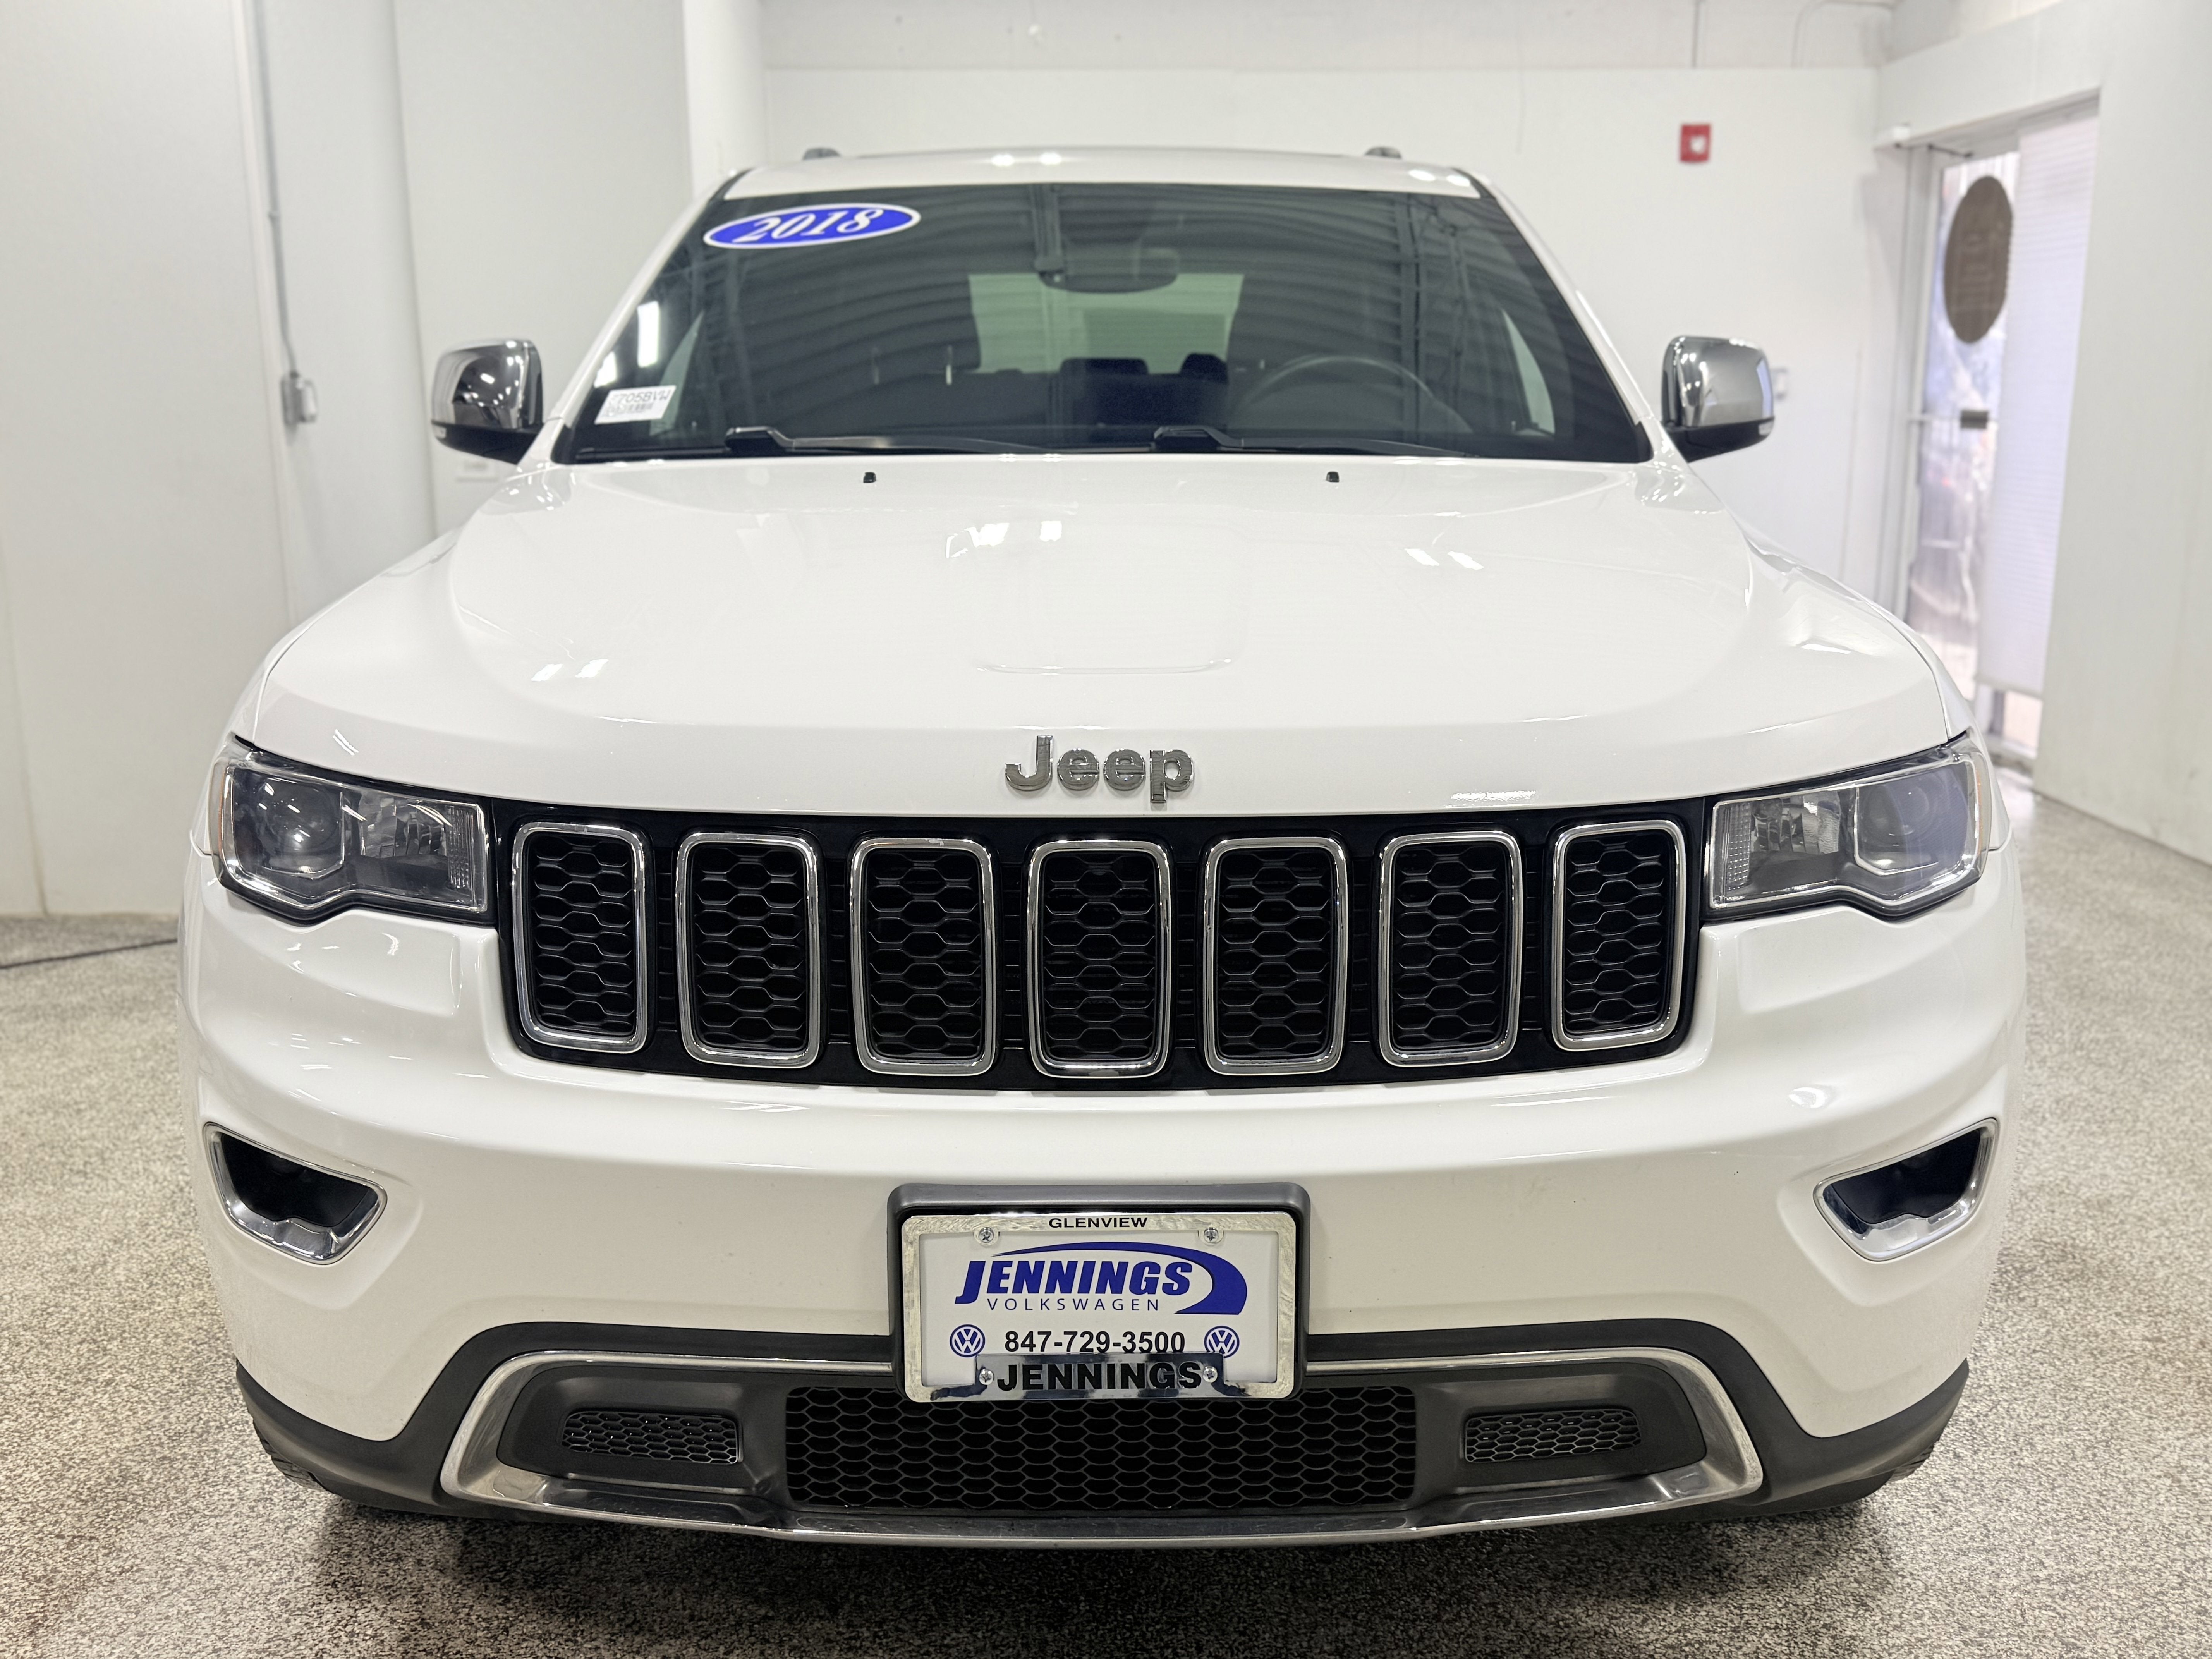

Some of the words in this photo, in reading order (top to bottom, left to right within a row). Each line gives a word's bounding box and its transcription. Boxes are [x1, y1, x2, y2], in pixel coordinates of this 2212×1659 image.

[732, 209, 884, 243] 2018
[1005, 735, 1194, 803] Jeep
[1049, 1217, 1148, 1228] GLENVIEW
[955, 1261, 1193, 1304] JENNINGS
[987, 1298, 1158, 1311] VOLKSWAGEN
[1005, 1331, 1185, 1353] 847-729-3500
[997, 1362, 1202, 1391] JENNINGS
